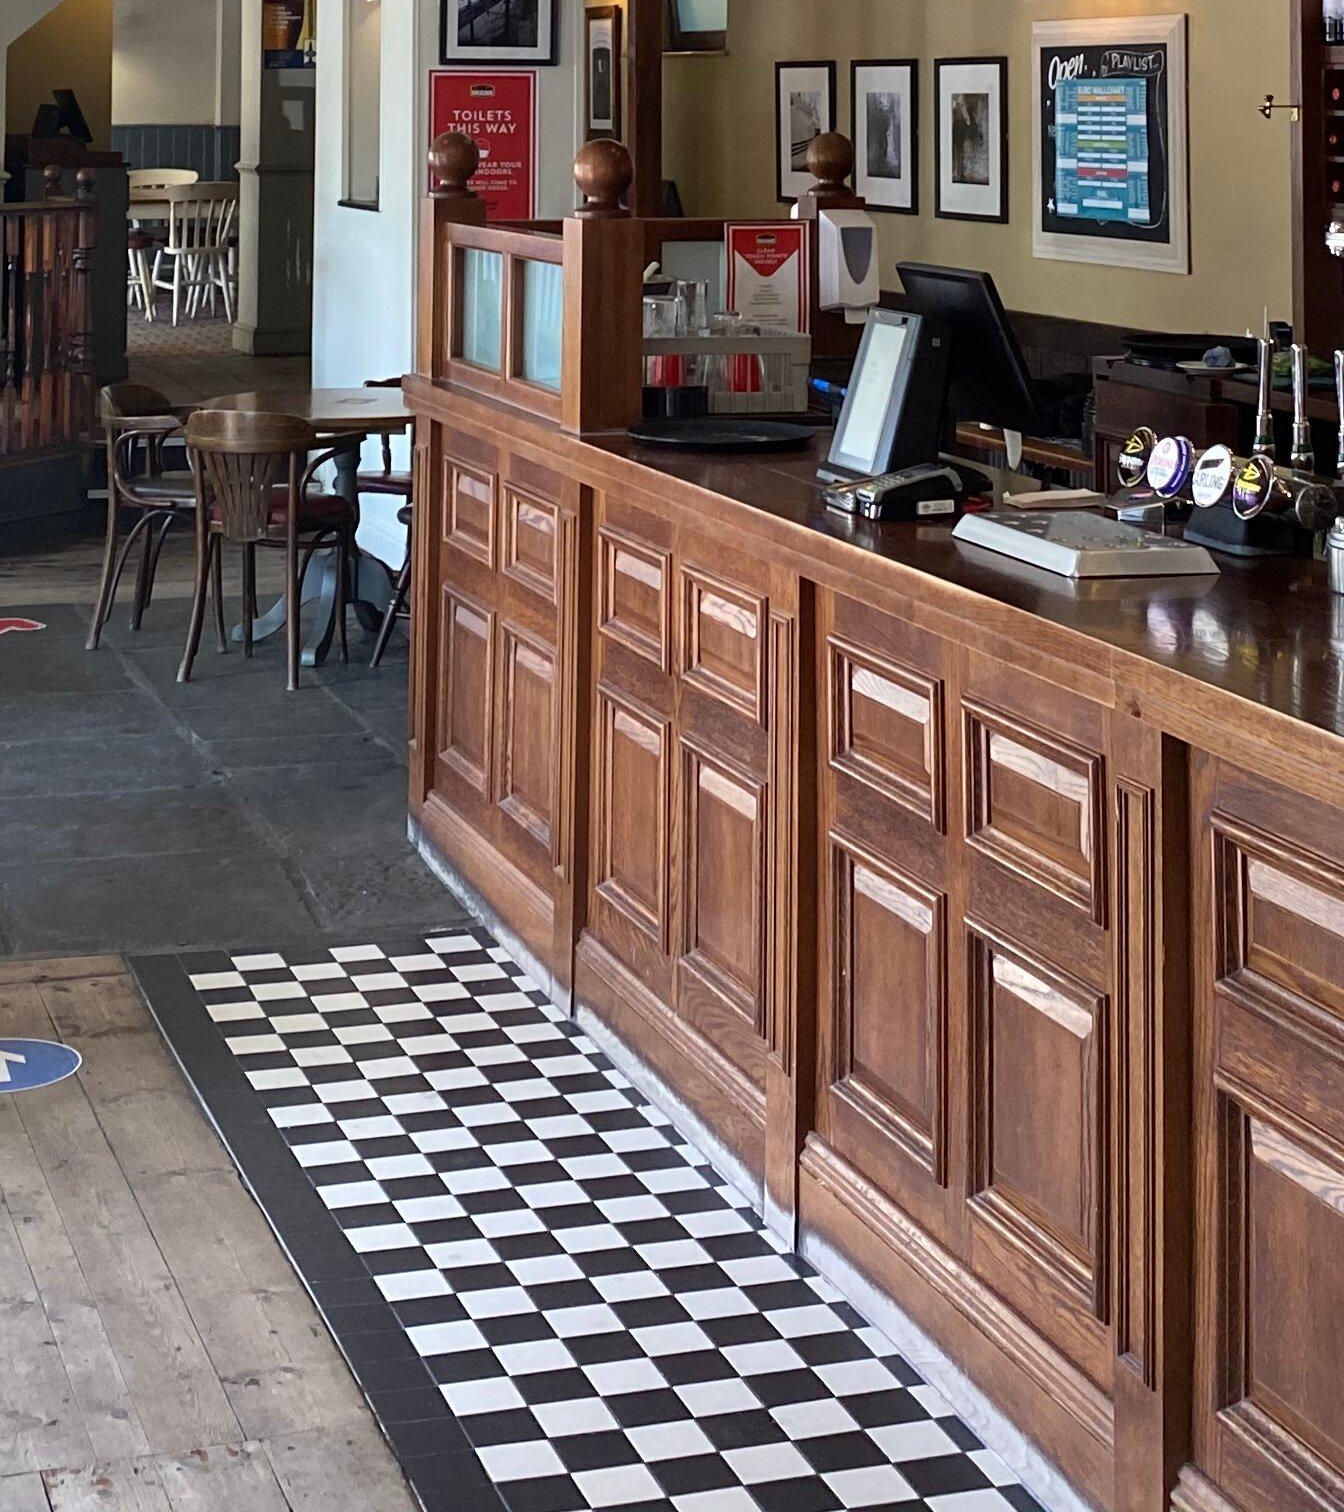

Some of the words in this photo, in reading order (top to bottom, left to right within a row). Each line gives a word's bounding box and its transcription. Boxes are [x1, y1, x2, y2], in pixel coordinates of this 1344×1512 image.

[453, 110, 512, 121] TOILETS
[448, 123, 480, 134] THIS
[486, 123, 517, 134] WAY
